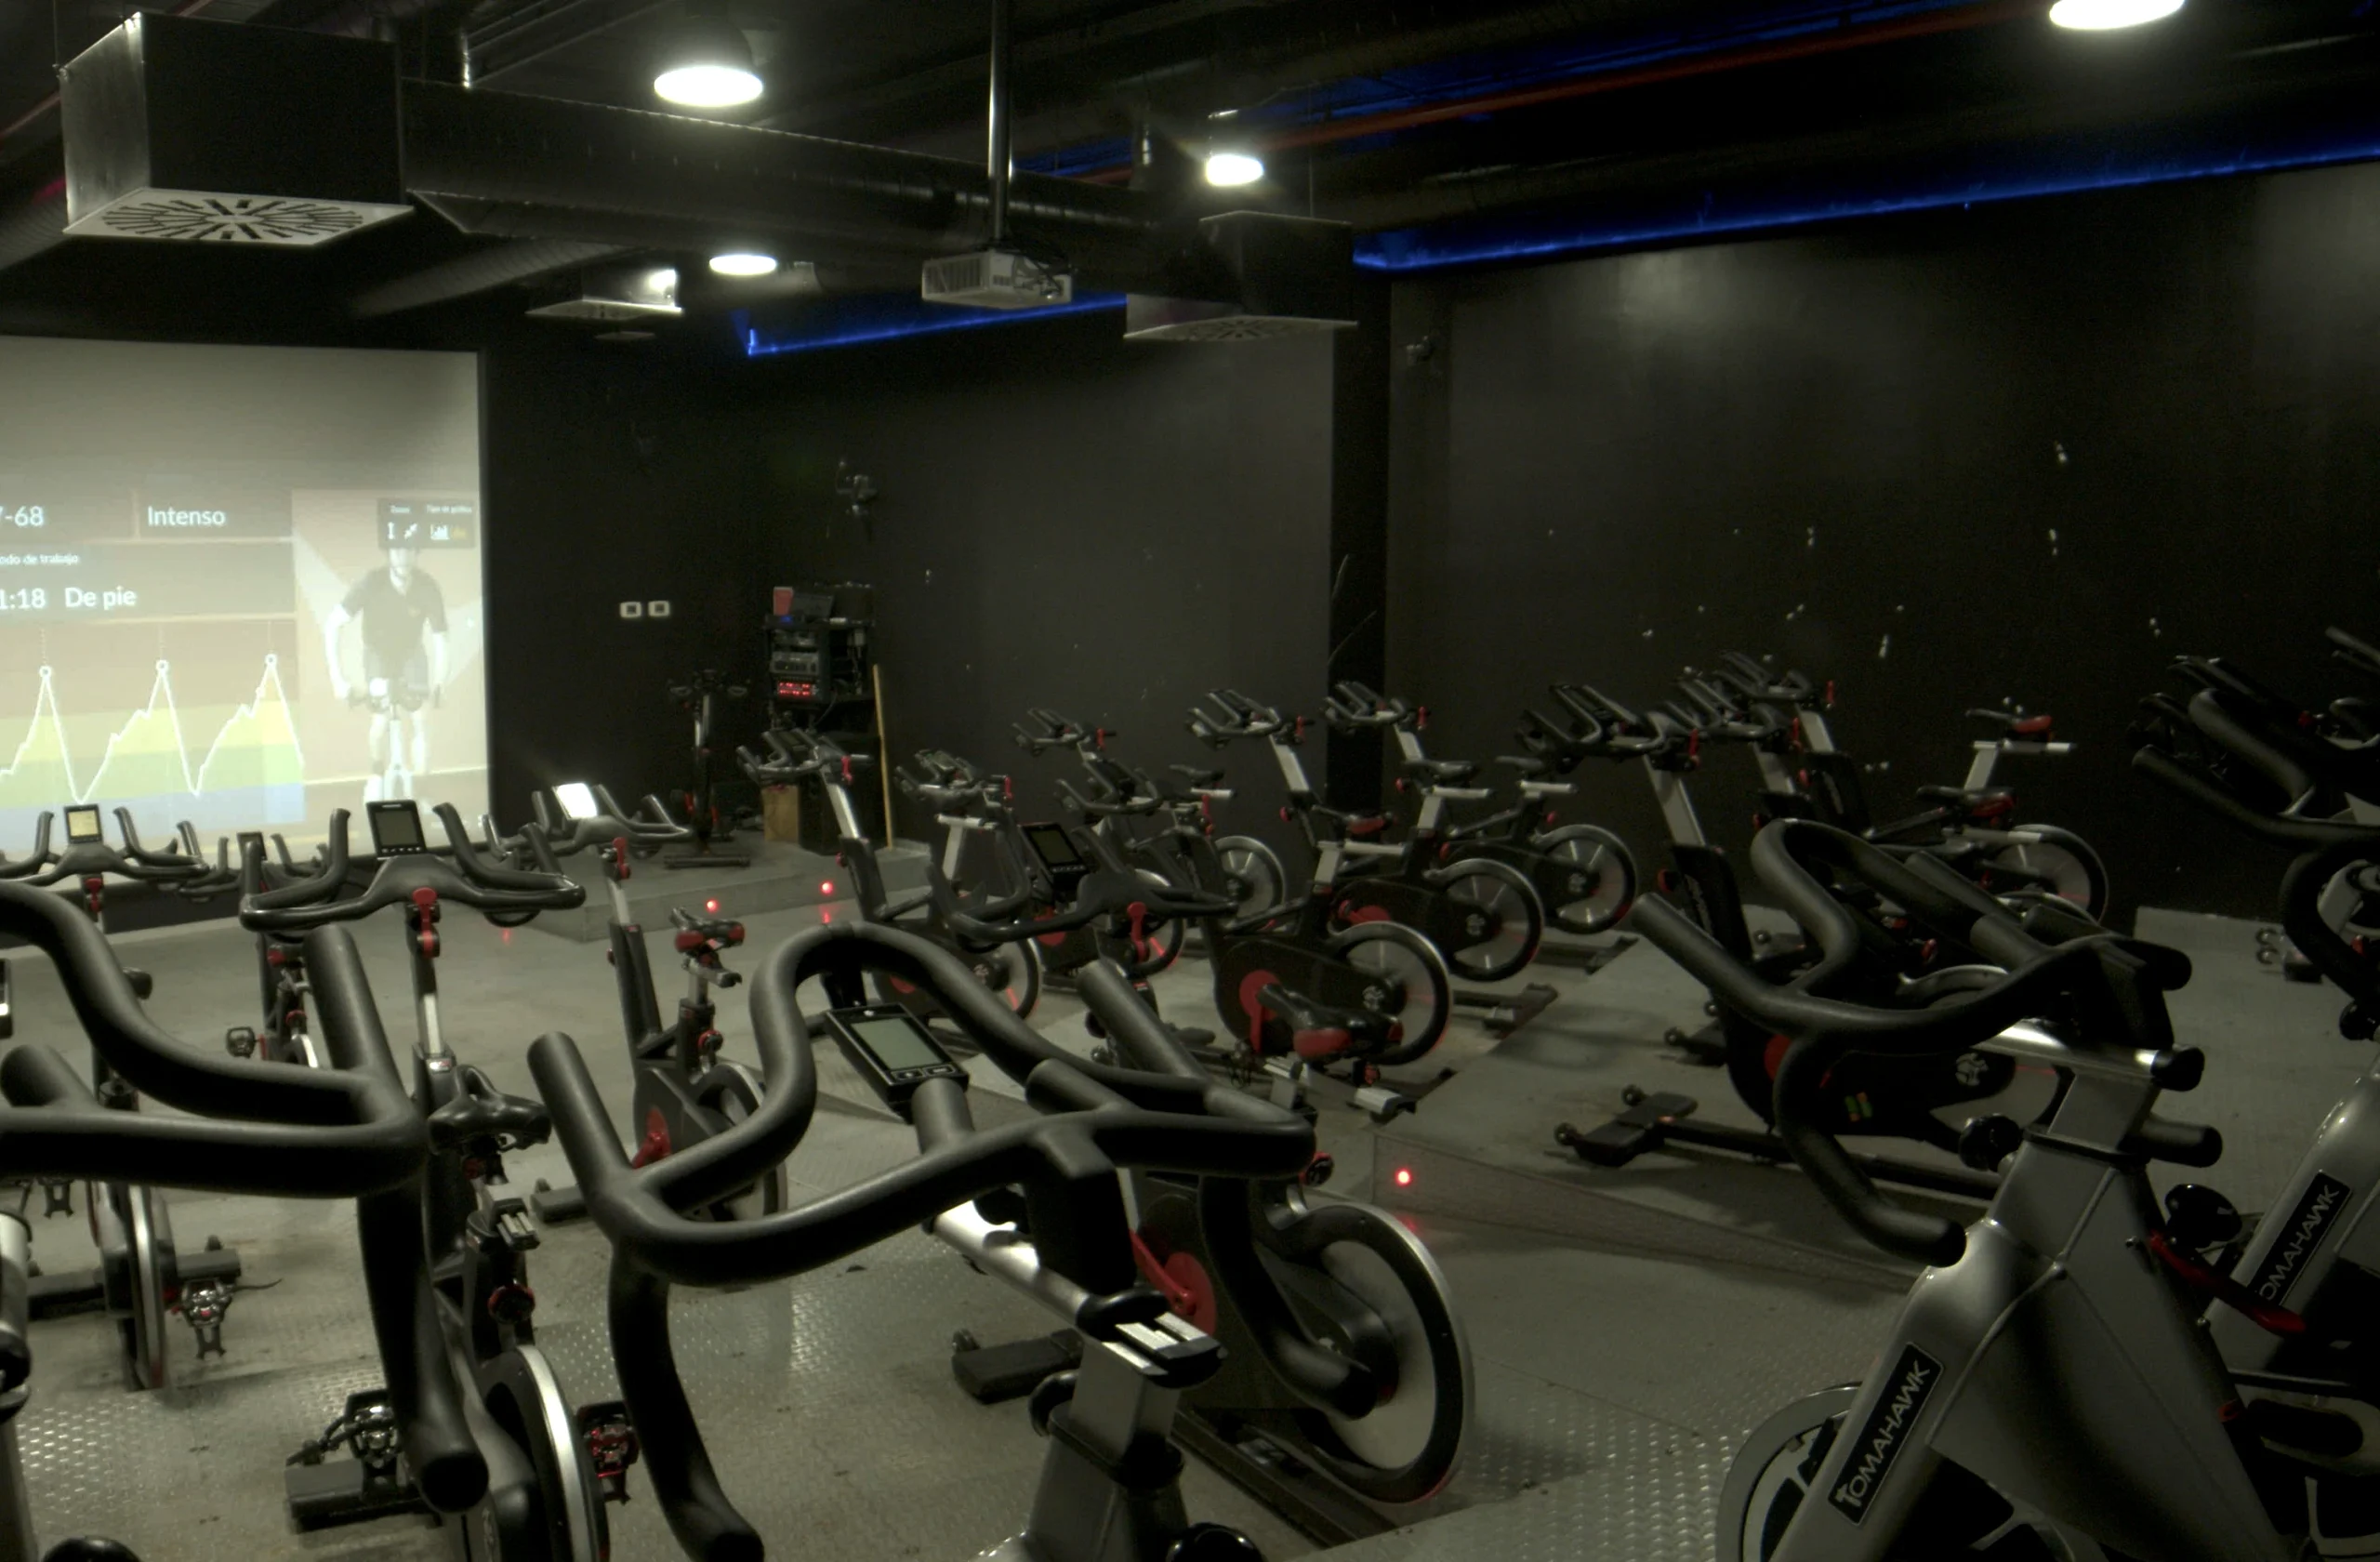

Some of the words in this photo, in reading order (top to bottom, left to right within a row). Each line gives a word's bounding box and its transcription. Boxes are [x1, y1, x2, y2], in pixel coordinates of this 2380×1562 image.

[0, 506, 44, 527] -68
[147, 505, 226, 527] Intenso
[64, 587, 97, 608] De
[102, 585, 137, 611] pie
[2258, 1185, 2340, 1300] OMAHAWK
[1834, 1359, 1931, 1507] TOMAHAWK
